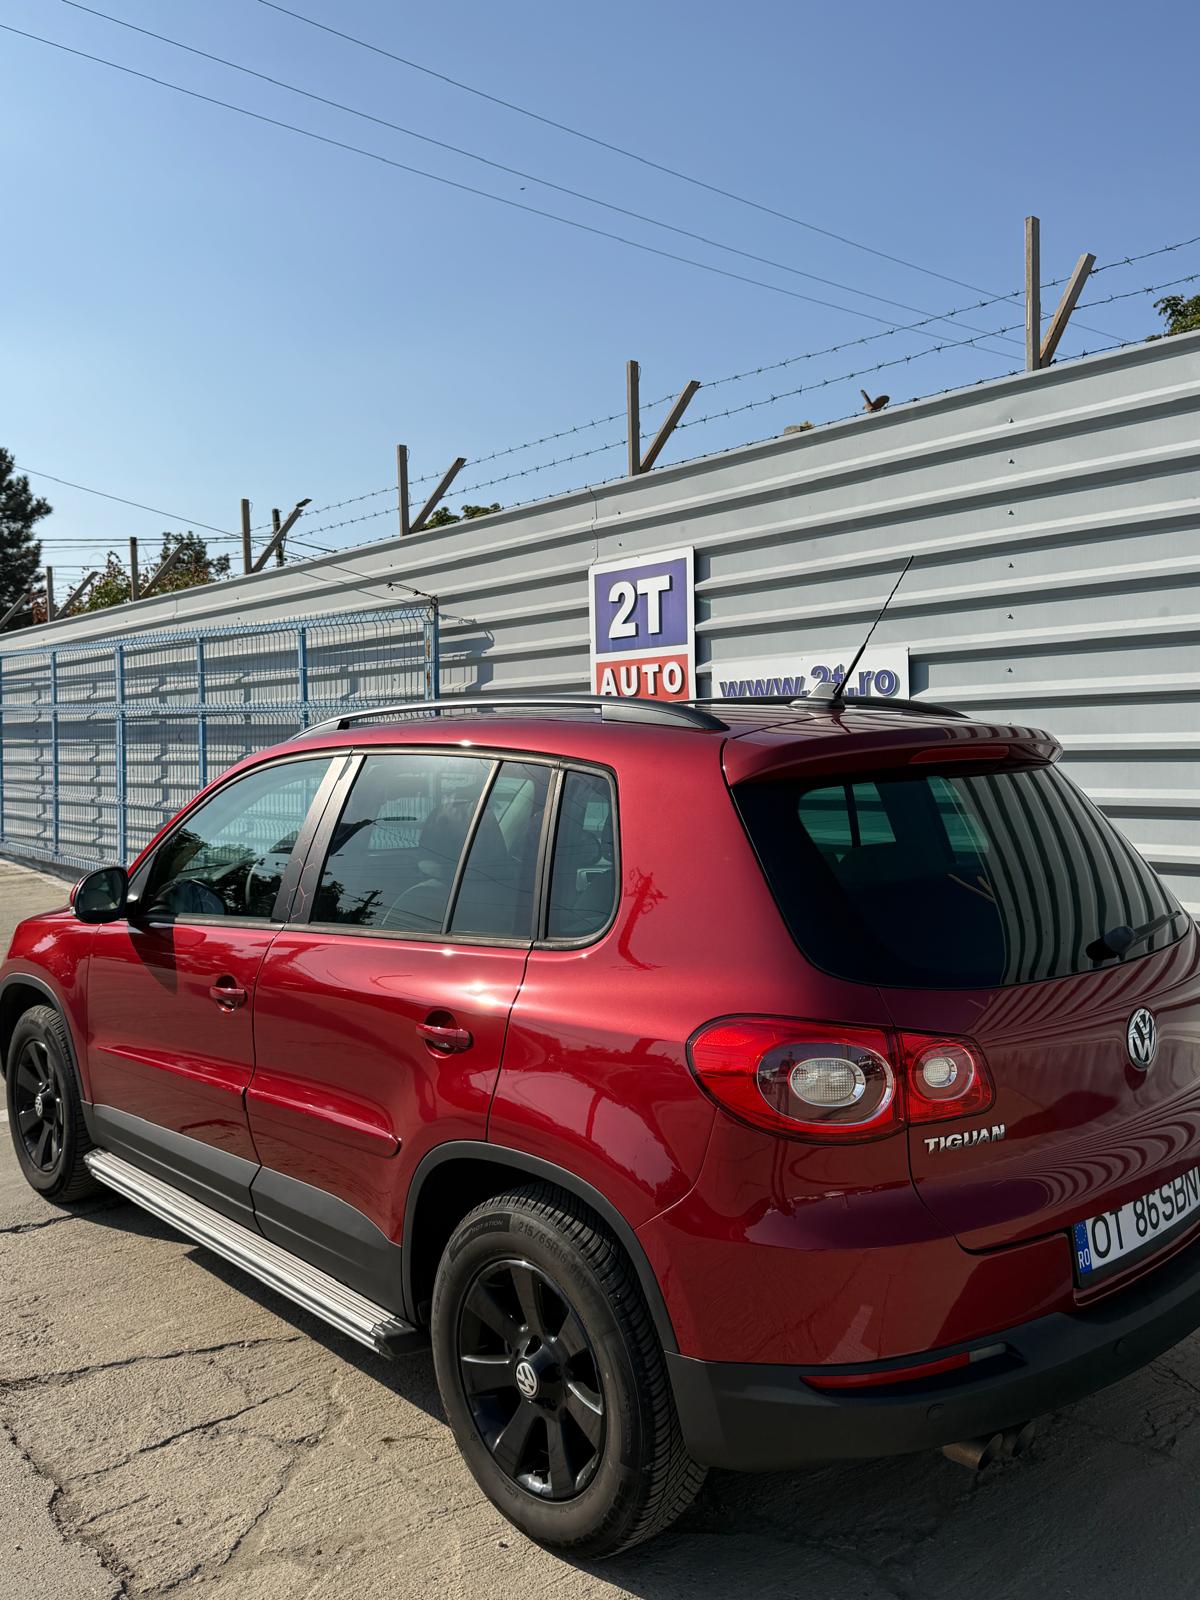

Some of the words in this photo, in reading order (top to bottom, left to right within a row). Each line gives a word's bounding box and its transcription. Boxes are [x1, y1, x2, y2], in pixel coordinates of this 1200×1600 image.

[608, 574, 671, 639] 2T
[600, 660, 684, 697] AUTO
[924, 1124, 1006, 1154] TIGUAN
[1091, 1208, 1125, 1259] OT
[1078, 1248, 1091, 1269] RO
